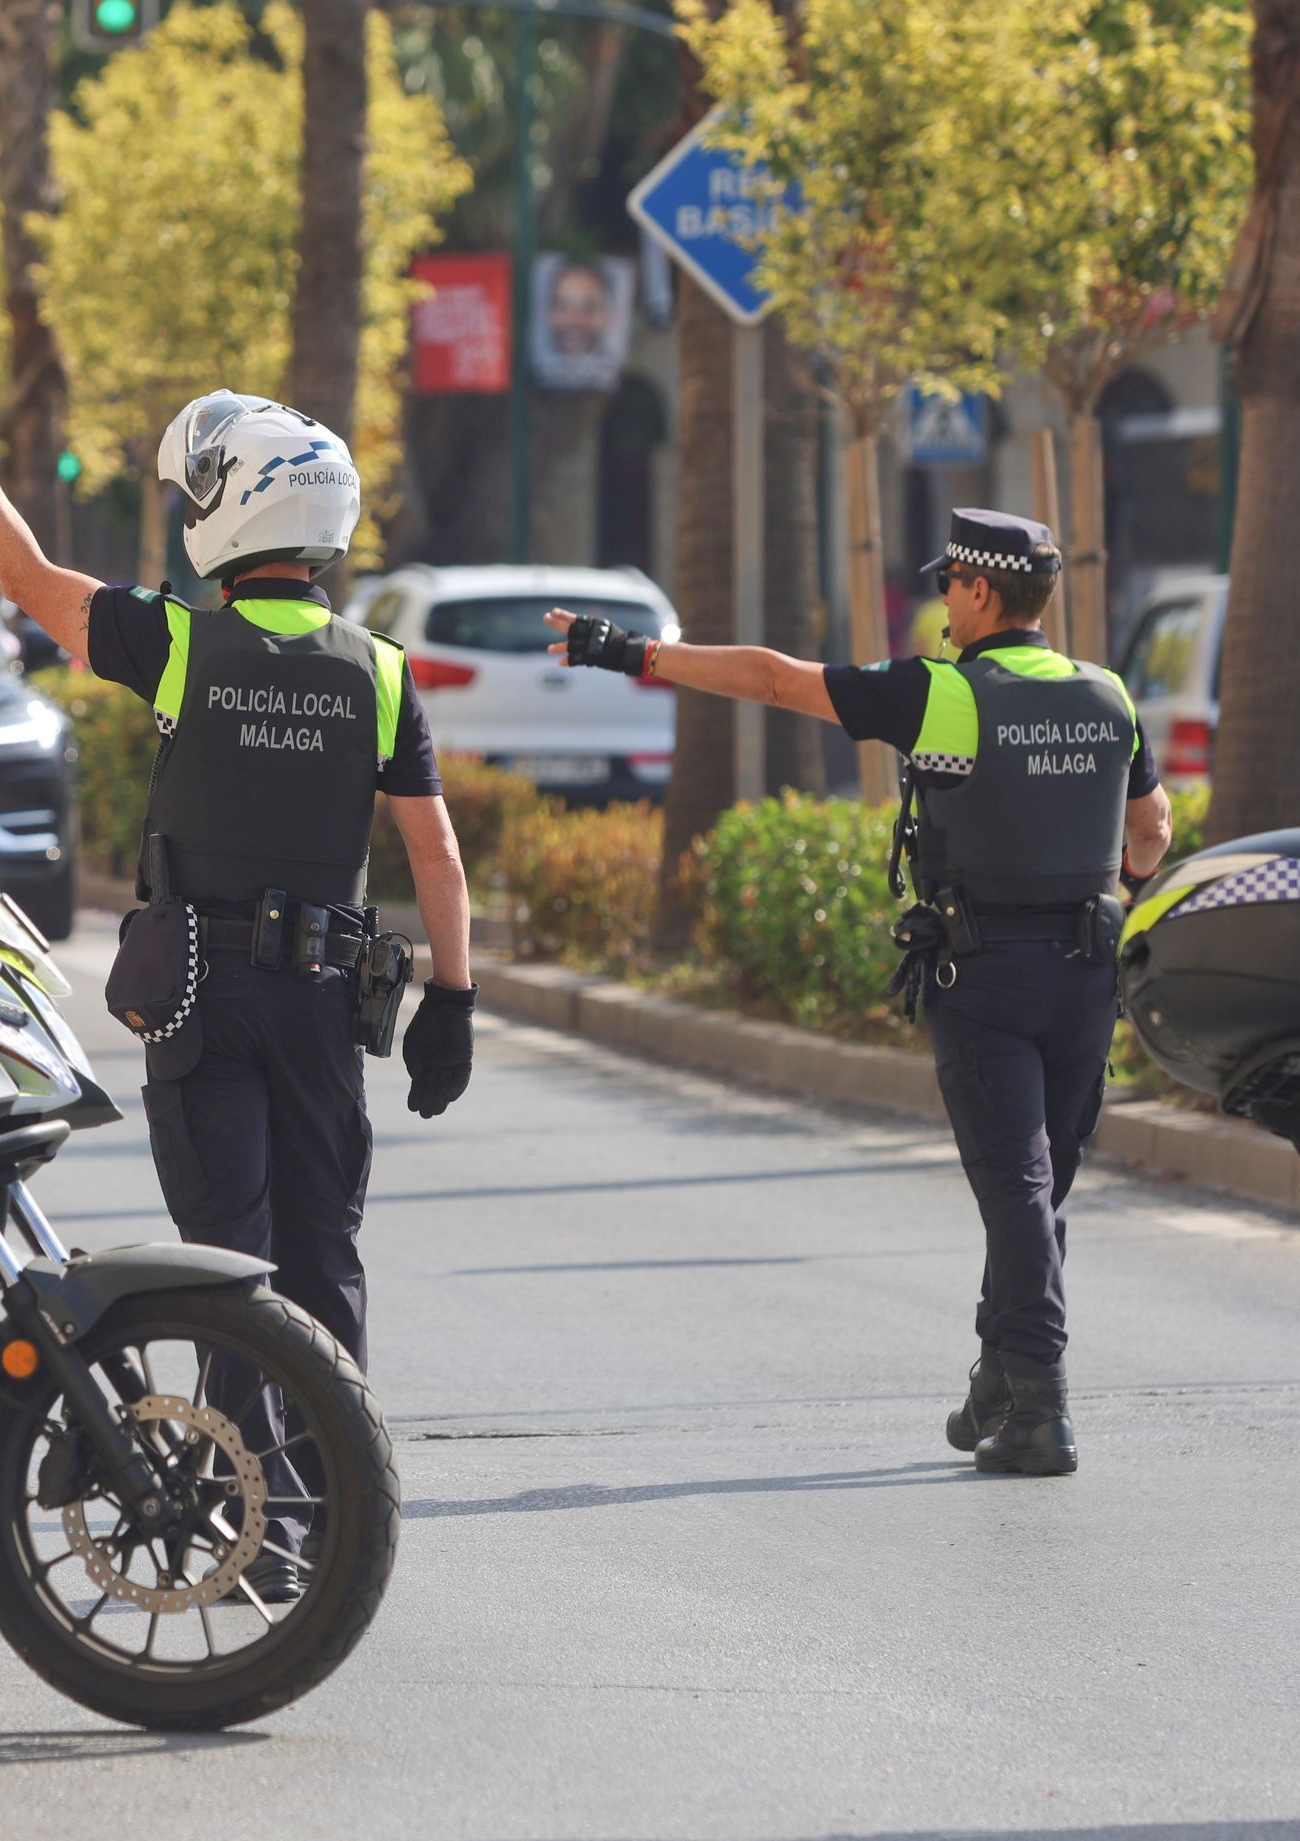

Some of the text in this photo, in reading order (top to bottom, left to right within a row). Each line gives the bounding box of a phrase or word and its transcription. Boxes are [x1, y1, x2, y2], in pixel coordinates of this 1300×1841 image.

[709, 167, 790, 203] RE
[288, 468, 336, 487] POLICÍA
[207, 685, 357, 719] POLICÍA LOCAL
[239, 720, 324, 752] MÁLAGA
[997, 718, 1120, 746] POLICÍA LOCAL
[1027, 749, 1097, 776] MÁLAGA
